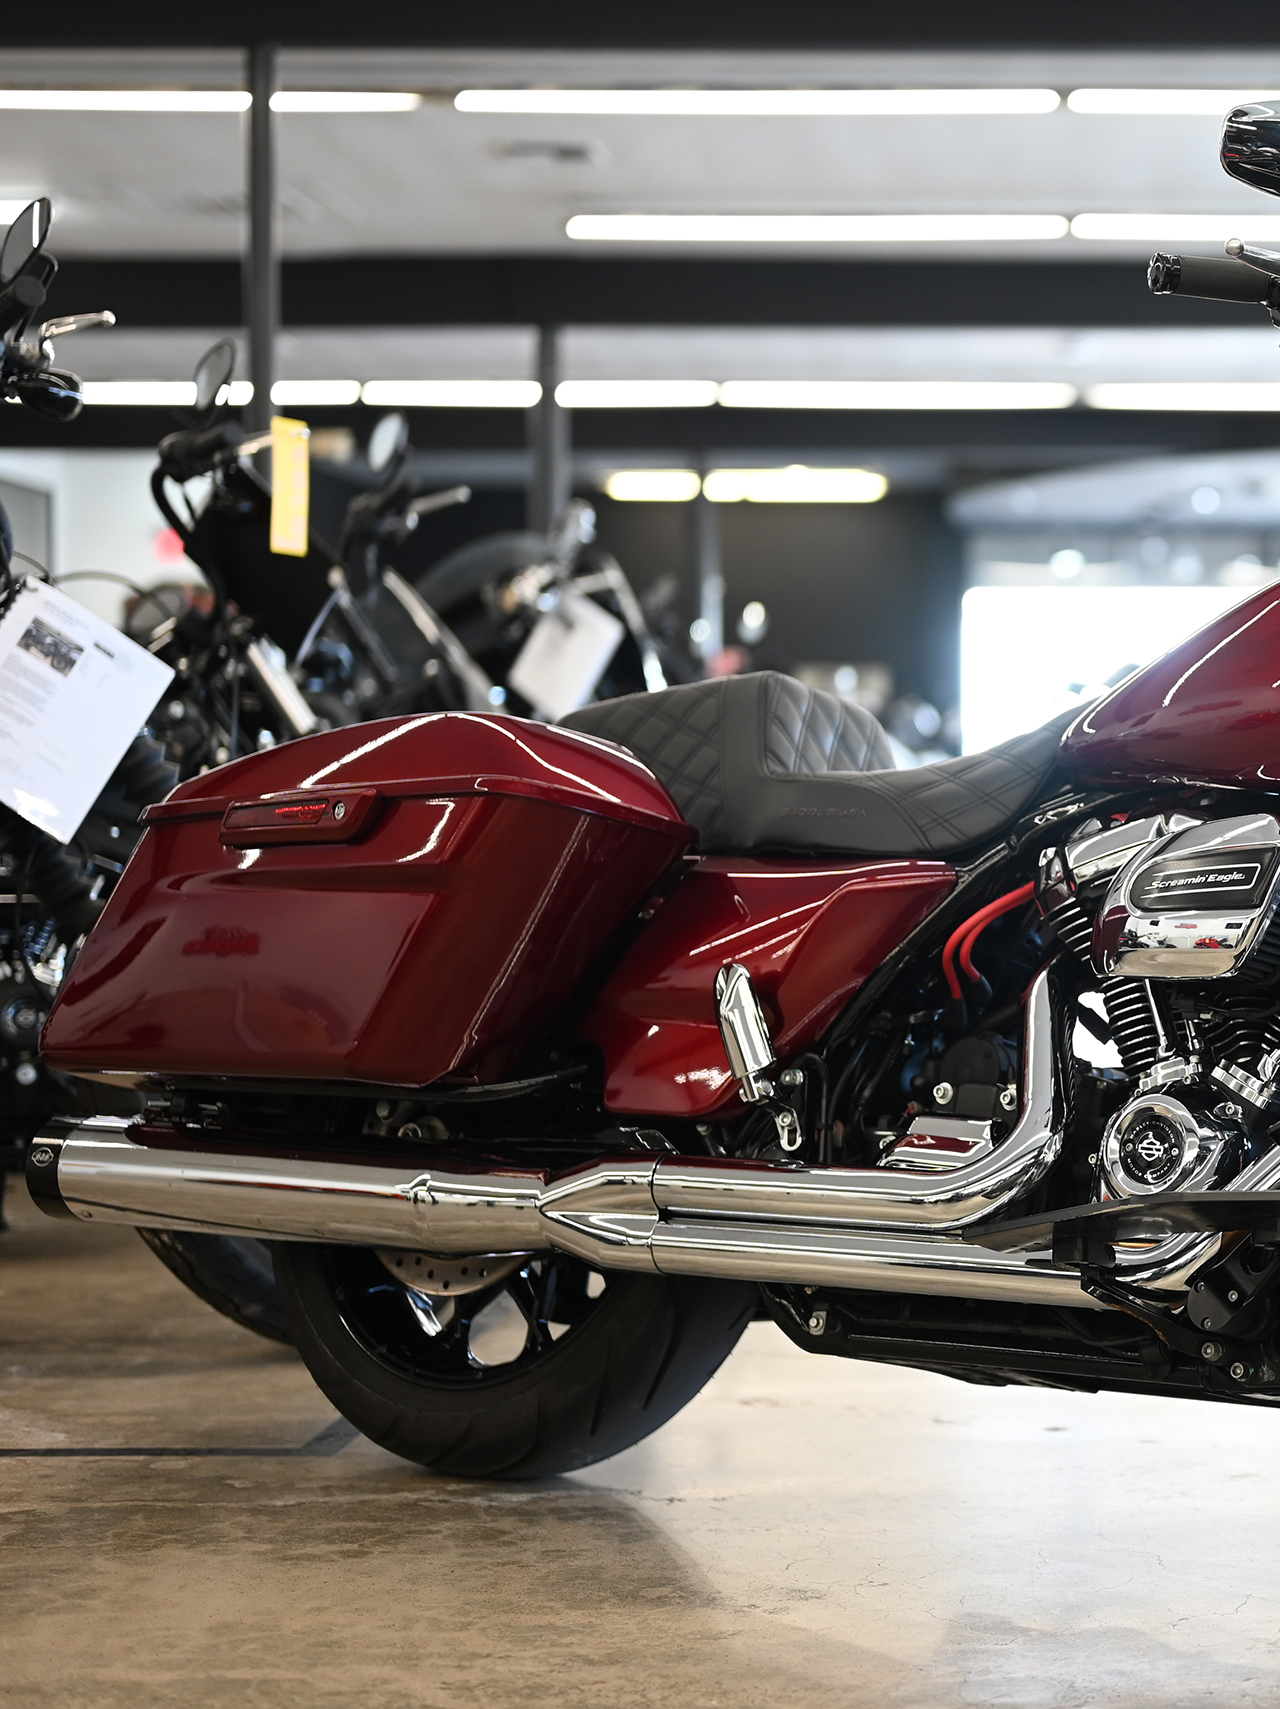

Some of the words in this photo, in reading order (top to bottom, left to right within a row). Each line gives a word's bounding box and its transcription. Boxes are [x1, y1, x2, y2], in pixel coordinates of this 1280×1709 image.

[1147, 875, 1209, 889] Screamin'
[1207, 871, 1245, 883] Eagle
[1127, 1158, 1143, 1177] MOTOR
